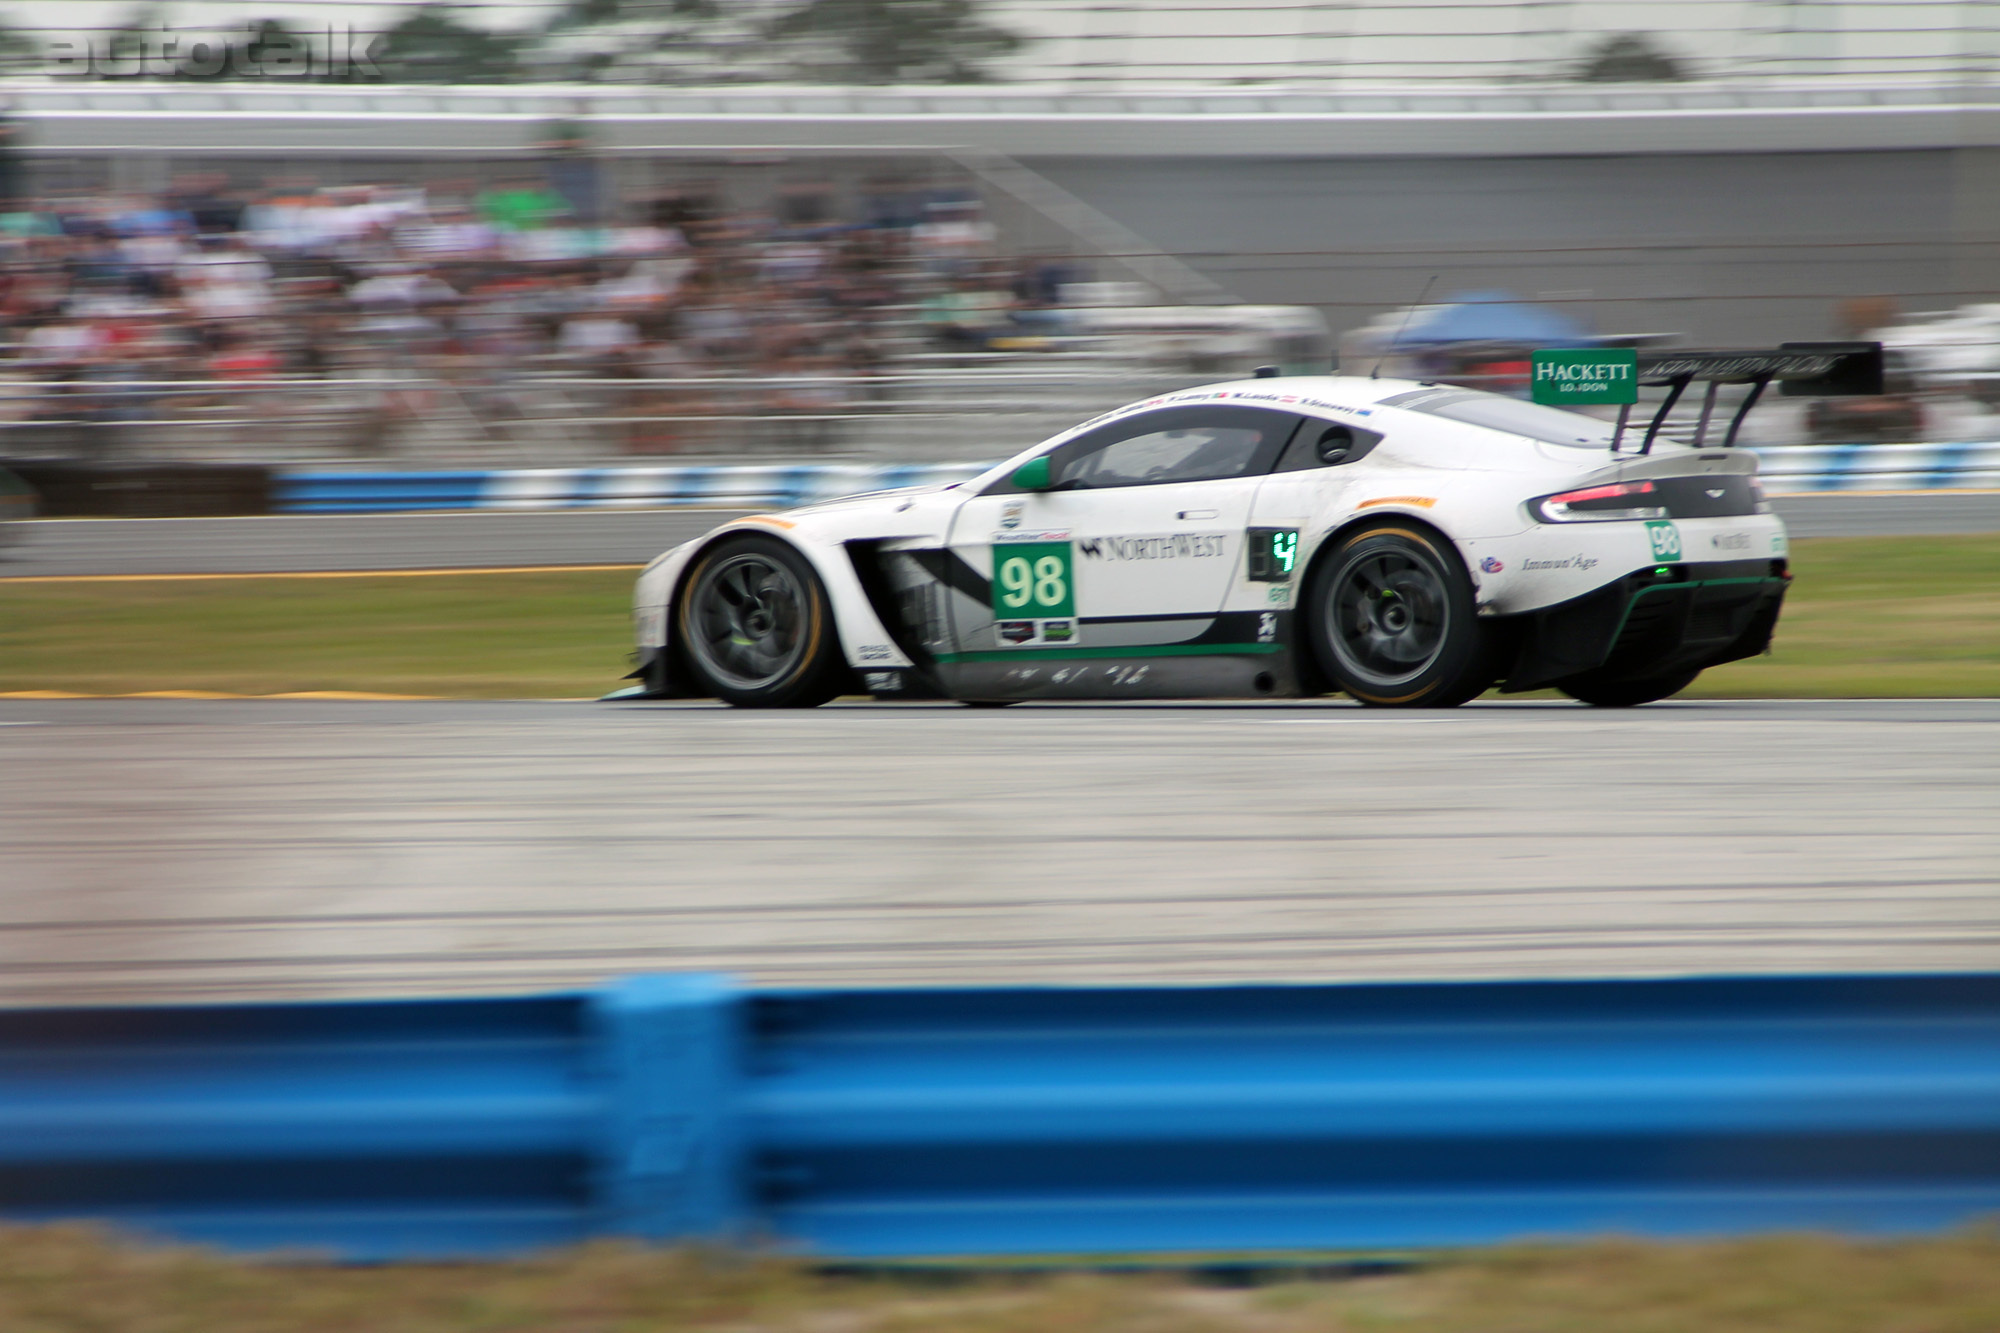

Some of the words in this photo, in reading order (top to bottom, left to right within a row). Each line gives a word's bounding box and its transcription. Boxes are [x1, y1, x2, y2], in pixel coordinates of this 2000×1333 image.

[1536, 362, 1631, 380] HACKETT
[1106, 534, 1226, 561] NORTHWEST
[1273, 532, 1298, 572] 4
[1651, 526, 1679, 555] 98
[1002, 556, 1067, 608] 98
